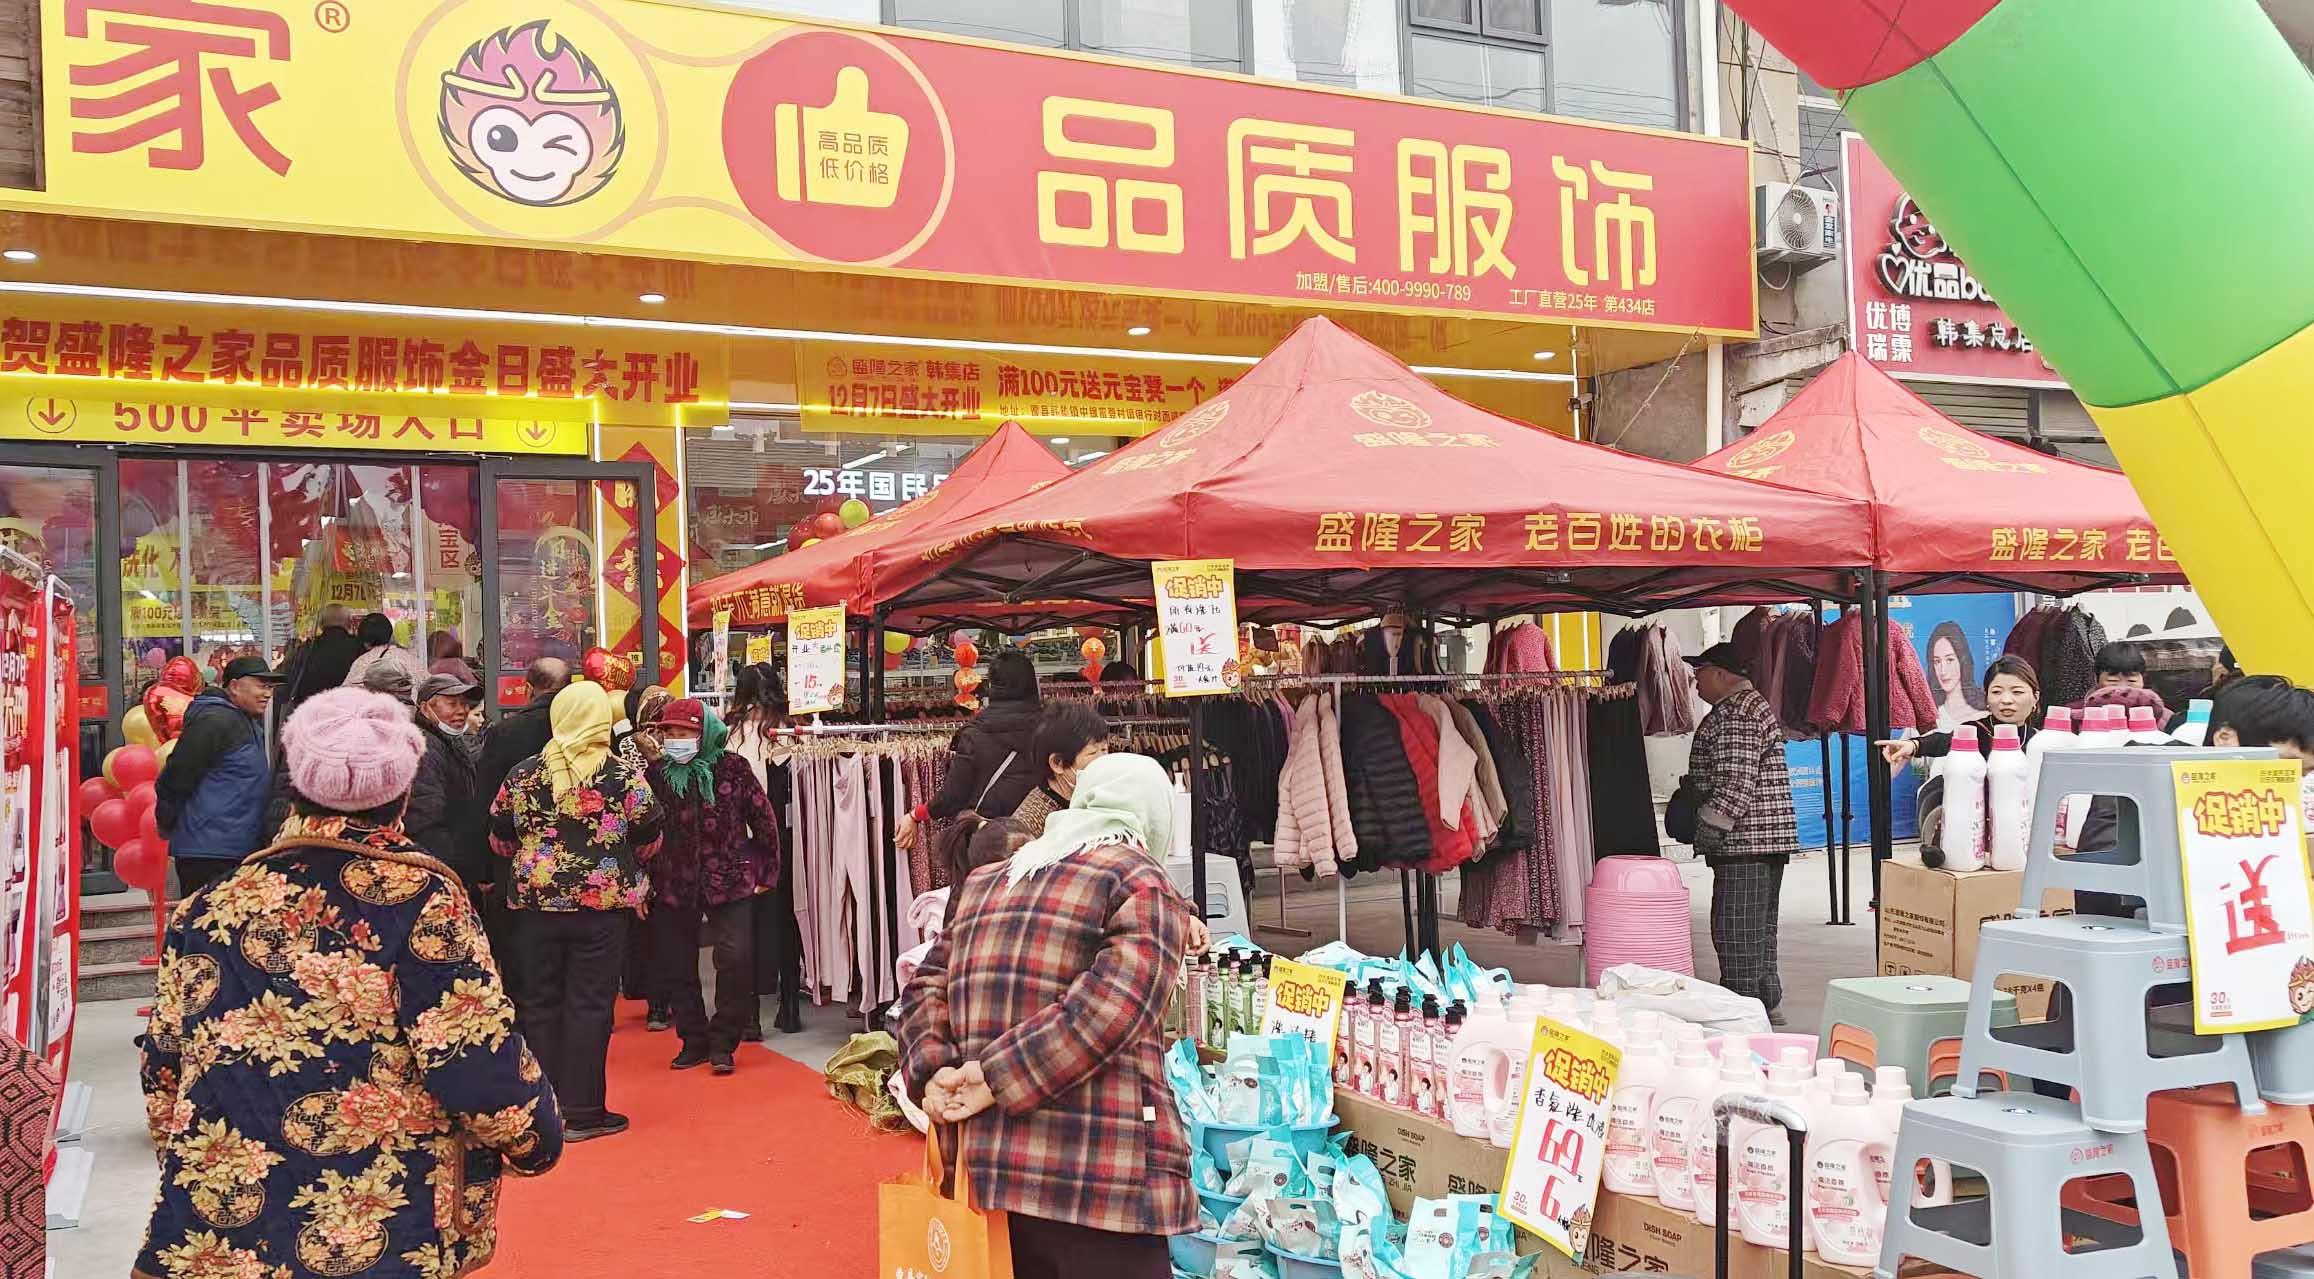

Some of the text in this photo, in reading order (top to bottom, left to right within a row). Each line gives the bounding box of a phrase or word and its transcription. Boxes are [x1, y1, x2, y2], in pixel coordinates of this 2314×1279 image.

[64, 0, 293, 178] 家
[818, 130, 889, 156] 高品质
[819, 157, 889, 185] 低价格
[1037, 95, 1657, 291] 品质服饰
[1508, 288, 1656, 316] 工厂直营25年 第434店
[1865, 301, 1911, 332] 优博
[852, 359, 981, 381] 盛隆之家 韩集店
[828, 383, 982, 421] 12月7日盛大开业
[1353, 431, 1502, 449] 盛隆之家
[1315, 511, 1765, 553] 盛隆之家 老百姓的衣柜
[1989, 527, 2108, 561] 盛隆之家
[1166, 574, 1224, 600] 促销中
[794, 618, 838, 641] 促销中
[2193, 788, 2287, 839] 促销中
[2219, 853, 2287, 956] 送
[1276, 980, 1331, 1019] 促销中
[1543, 1048, 1610, 1105] 促销中
[1643, 1221, 1661, 1236] DISH
[1662, 1228, 1682, 1242] SOAP
